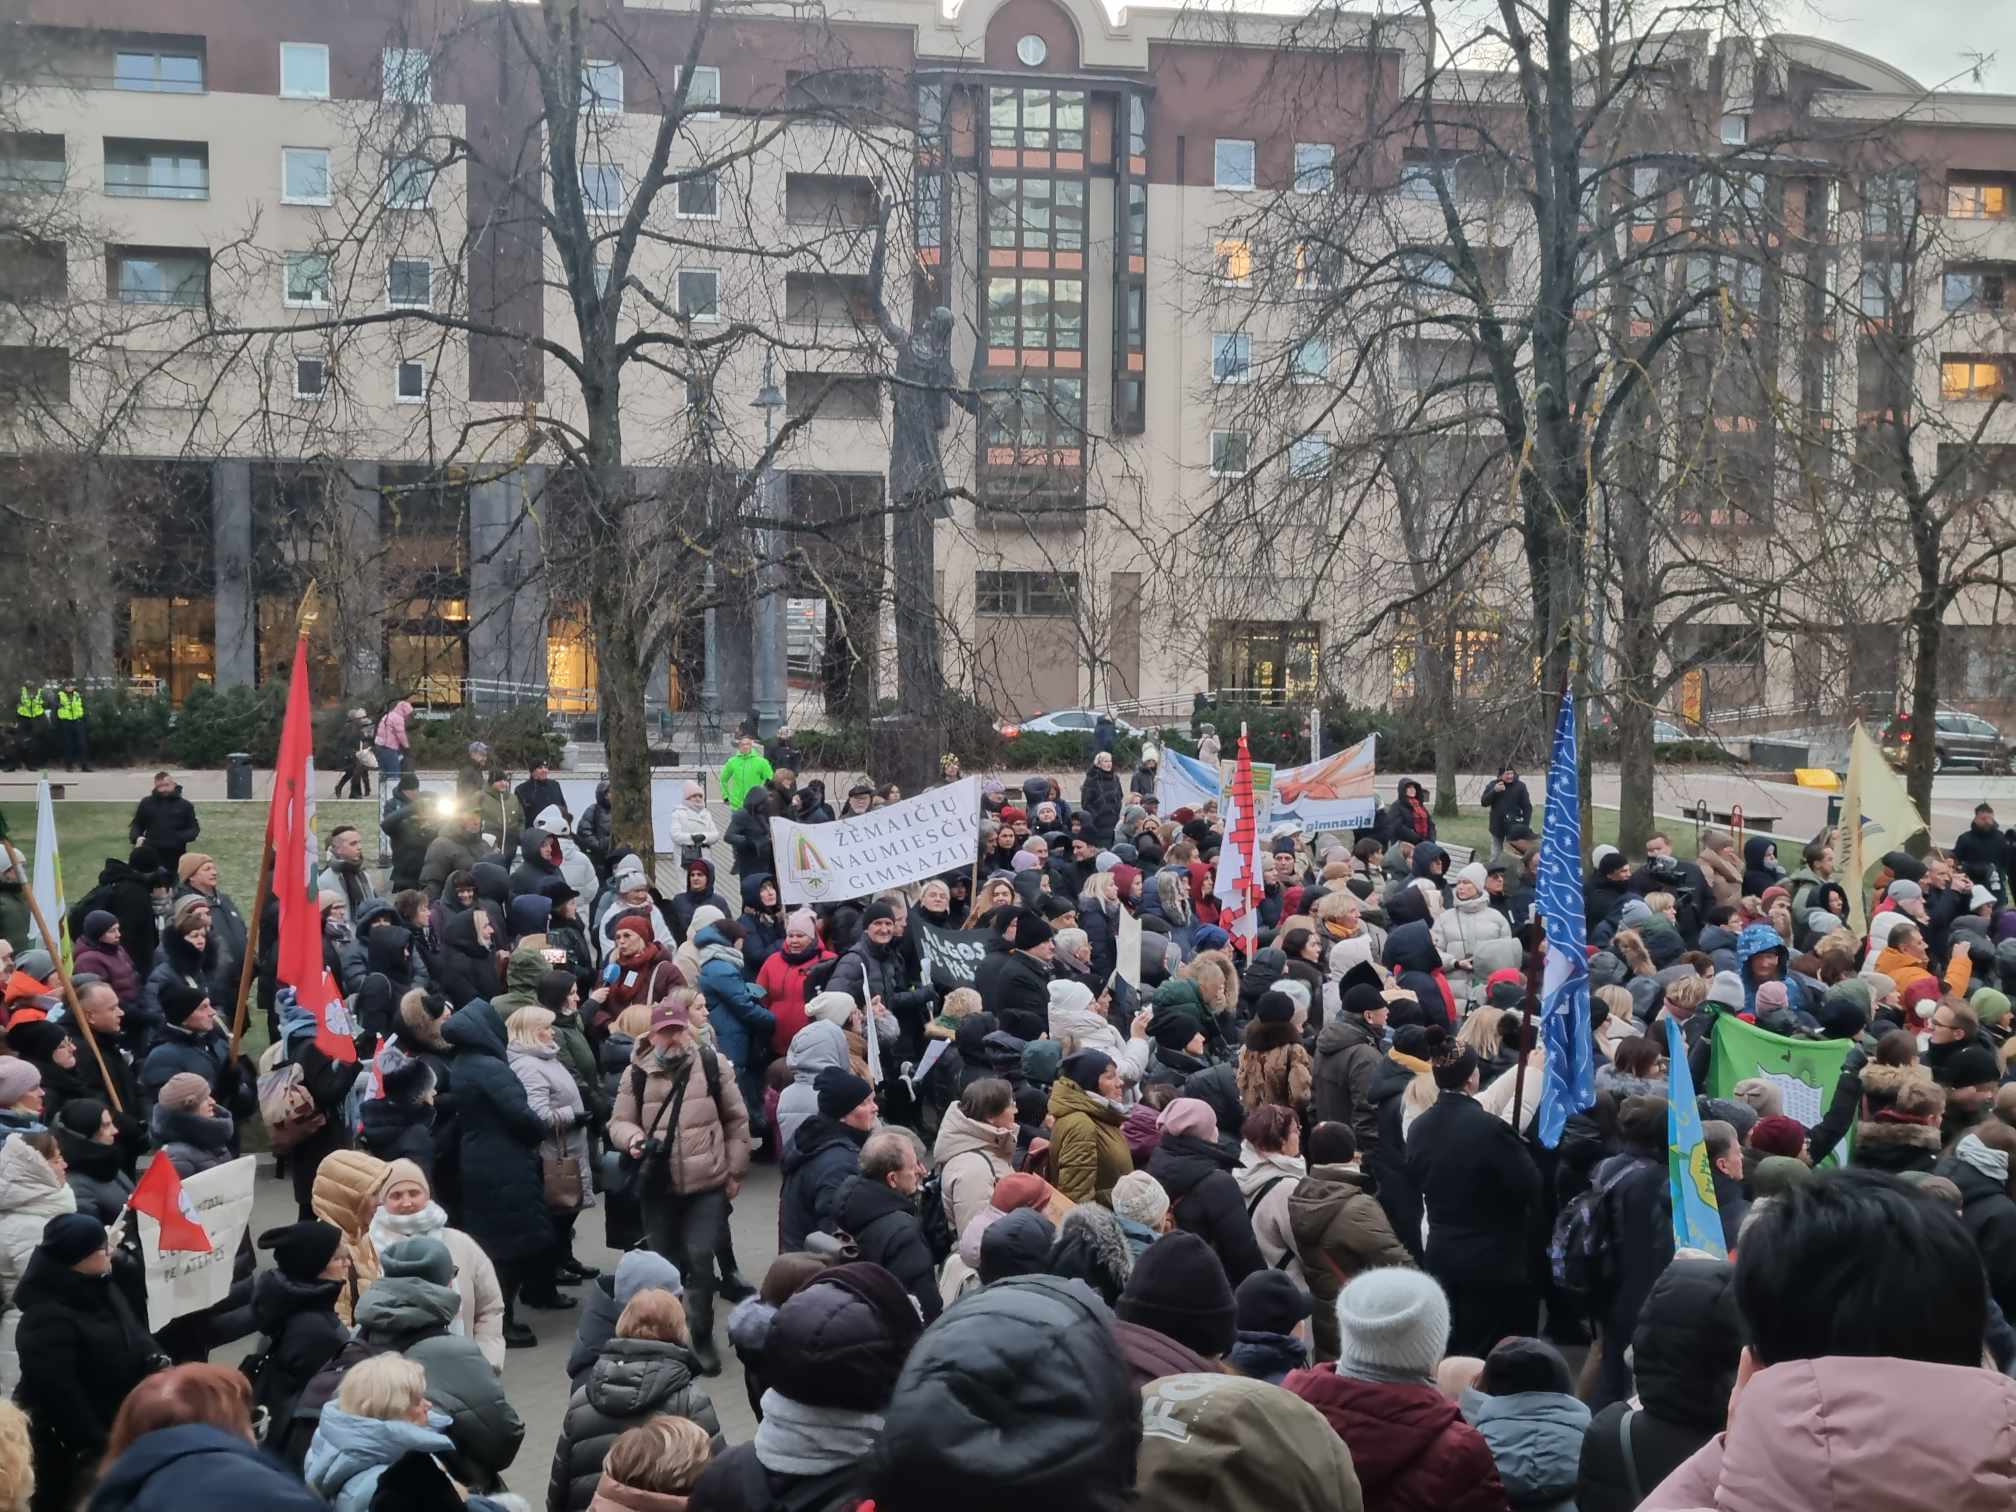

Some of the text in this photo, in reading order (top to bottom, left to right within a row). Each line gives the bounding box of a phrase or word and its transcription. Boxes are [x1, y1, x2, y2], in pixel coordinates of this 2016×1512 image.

[834, 796, 957, 847] ŽEMAIČIŲ
[1305, 816, 1371, 832] gimnazija
[923, 926, 986, 960] ALGOS
[943, 956, 977, 981] PAŠ
